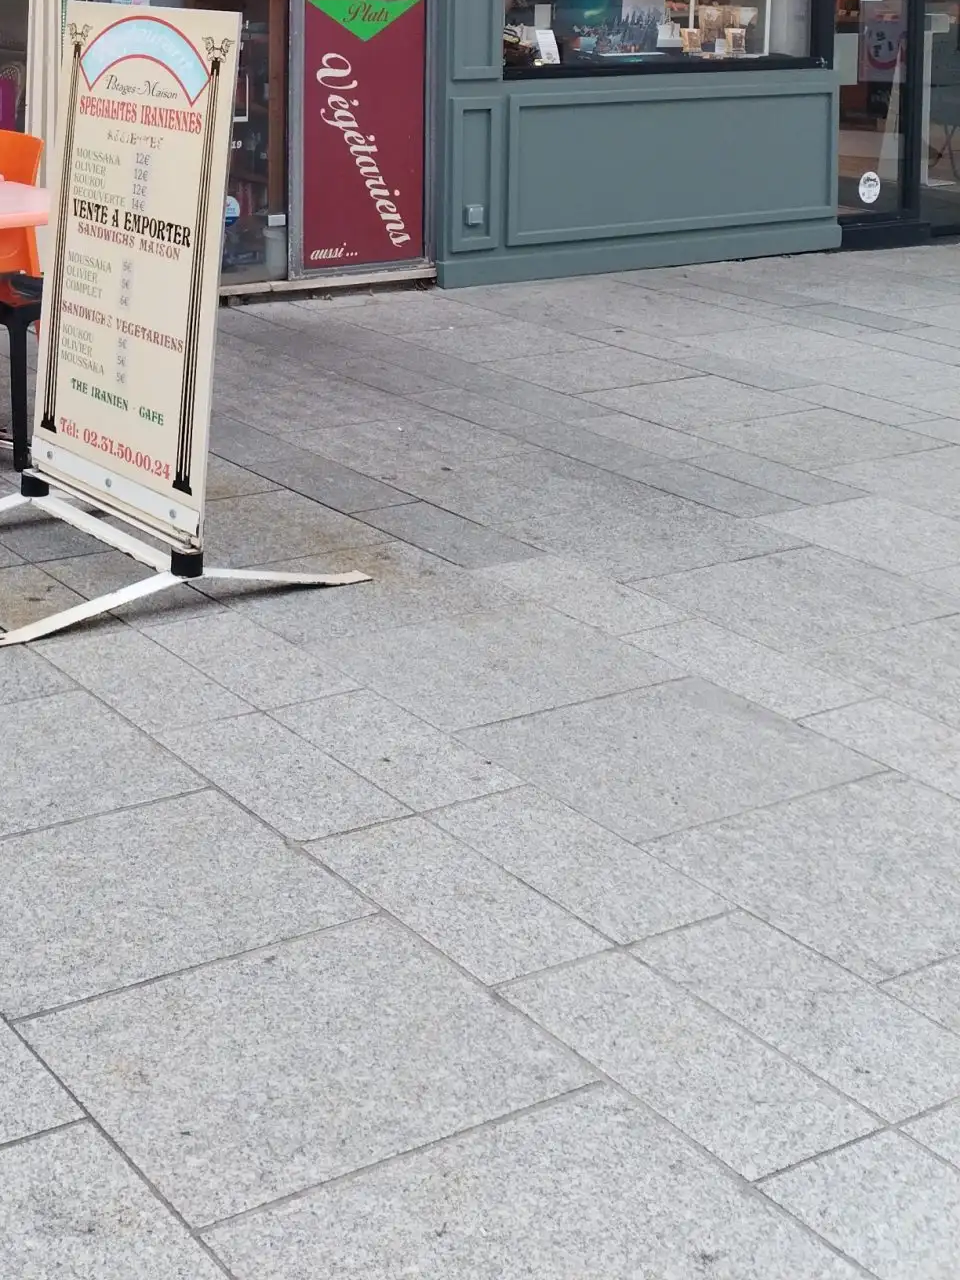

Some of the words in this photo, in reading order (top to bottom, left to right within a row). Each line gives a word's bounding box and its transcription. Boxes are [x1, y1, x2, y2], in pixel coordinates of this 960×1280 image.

[140, 104, 203, 135] IRANIENNES
[135, 152, 151, 166] 12€
[316, 52, 411, 248] Végétariens
[134, 168, 149, 182] 12€
[132, 183, 148, 197] 12€
[73, 198, 108, 224] VENTE
[124, 211, 192, 248] EMPORTER
[139, 238, 181, 261] MAISON
[66, 280, 103, 299] COMPLET
[116, 318, 184, 354] VEGETARIENS
[71, 378, 88, 396] THE
[91, 385, 129, 412] IRANIEN
